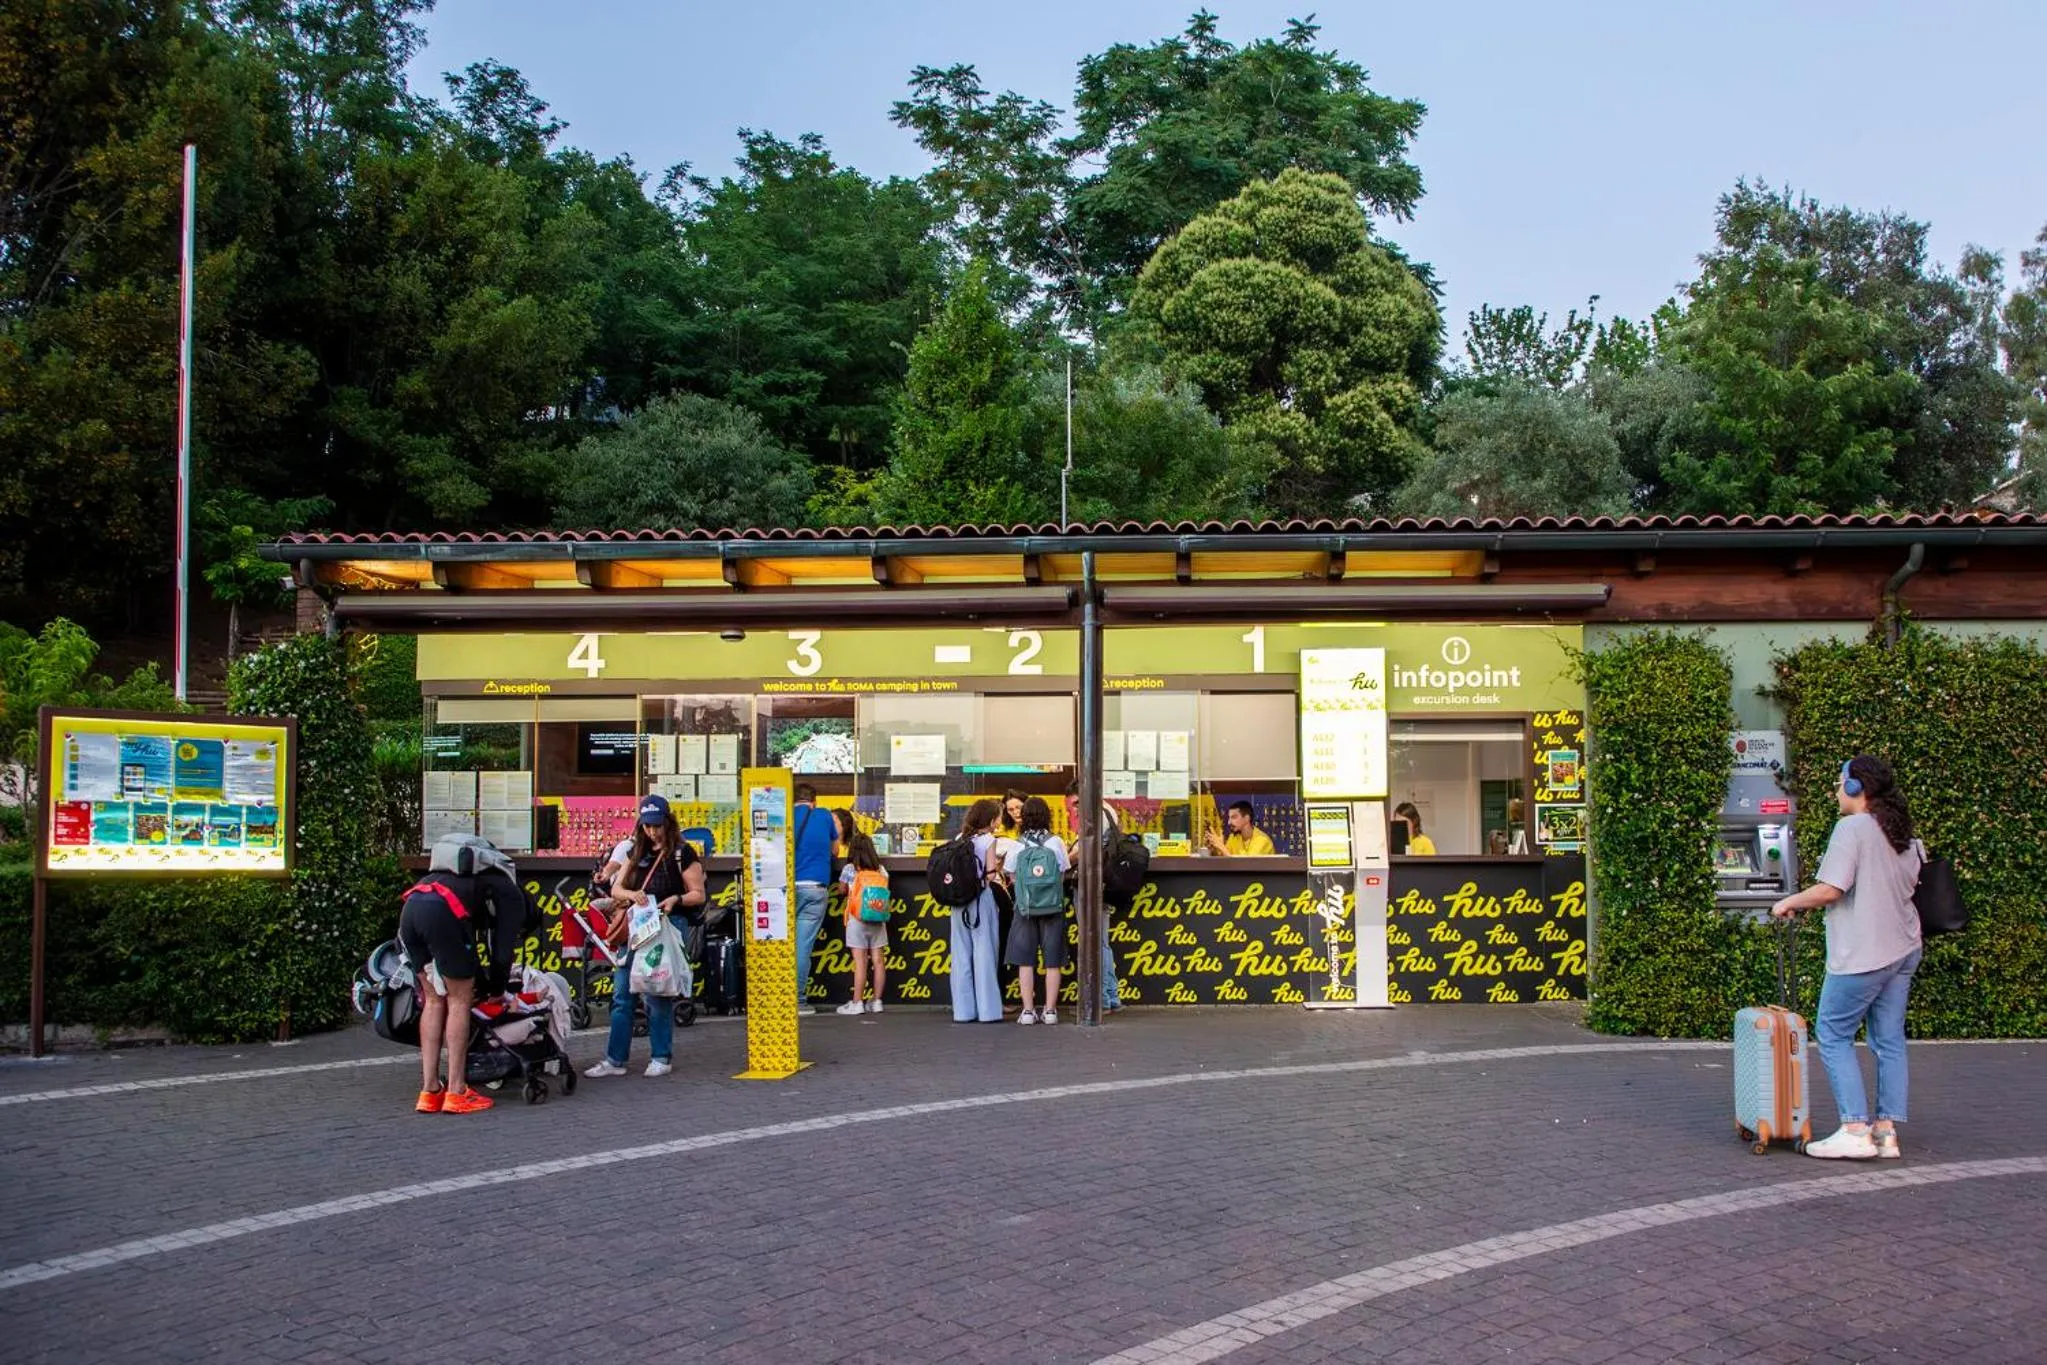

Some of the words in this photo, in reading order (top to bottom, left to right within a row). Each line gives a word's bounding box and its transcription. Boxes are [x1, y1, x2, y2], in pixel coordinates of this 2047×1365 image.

[567, 633, 606, 678] 4
[787, 631, 823, 677] 3
[1007, 630, 1043, 675] 2
[1242, 625, 1265, 673] 1
[763, 682, 813, 692] welcome
[815, 682, 826, 692] to
[846, 682, 874, 691] ROMA
[876, 682, 918, 693] camping
[921, 681, 930, 690] in
[931, 681, 958, 690] town
[1109, 677, 1164, 690] reception
[1348, 672, 1378, 691] hu
[1393, 664, 1521, 692] infopoint
[500, 683, 551, 695] reception
[1412, 694, 1469, 705] excursion
[1472, 693, 1501, 705] desk
[1533, 713, 1552, 728] u
[1553, 709, 1579, 725] hu
[1541, 731, 1563, 745] hu
[1535, 787, 1554, 802] u
[1129, 882, 1181, 918] hu
[1183, 890, 1222, 915] hu
[1230, 882, 1287, 919] hu
[1317, 884, 1345, 928] hu
[1396, 889, 1436, 914] hu
[1443, 882, 1501, 918] hu
[1503, 889, 1543, 914] hu
[899, 920, 930, 942] hu
[1108, 921, 1140, 942] hu
[1165, 924, 1197, 945] hu
[1214, 921, 1247, 942] hu
[1271, 924, 1304, 945] hu
[1427, 921, 1461, 942] hu
[1485, 924, 1518, 944] hu
[1535, 921, 1568, 941] hu
[1124, 940, 1181, 976] hu
[1183, 947, 1223, 972] hu
[1230, 940, 1287, 976] hu
[1289, 947, 1329, 973] hu
[1329, 945, 1341, 992] welcome
[1396, 947, 1436, 972] hu
[1444, 940, 1502, 976] hu
[1504, 947, 1544, 971] hu
[900, 977, 930, 997] hu
[1165, 982, 1197, 1002] hu
[1214, 979, 1247, 1000] hu
[1272, 982, 1304, 1002] hu
[1428, 979, 1462, 1000] hu
[1487, 982, 1519, 1002] hu
[1536, 979, 1569, 1000] hu
